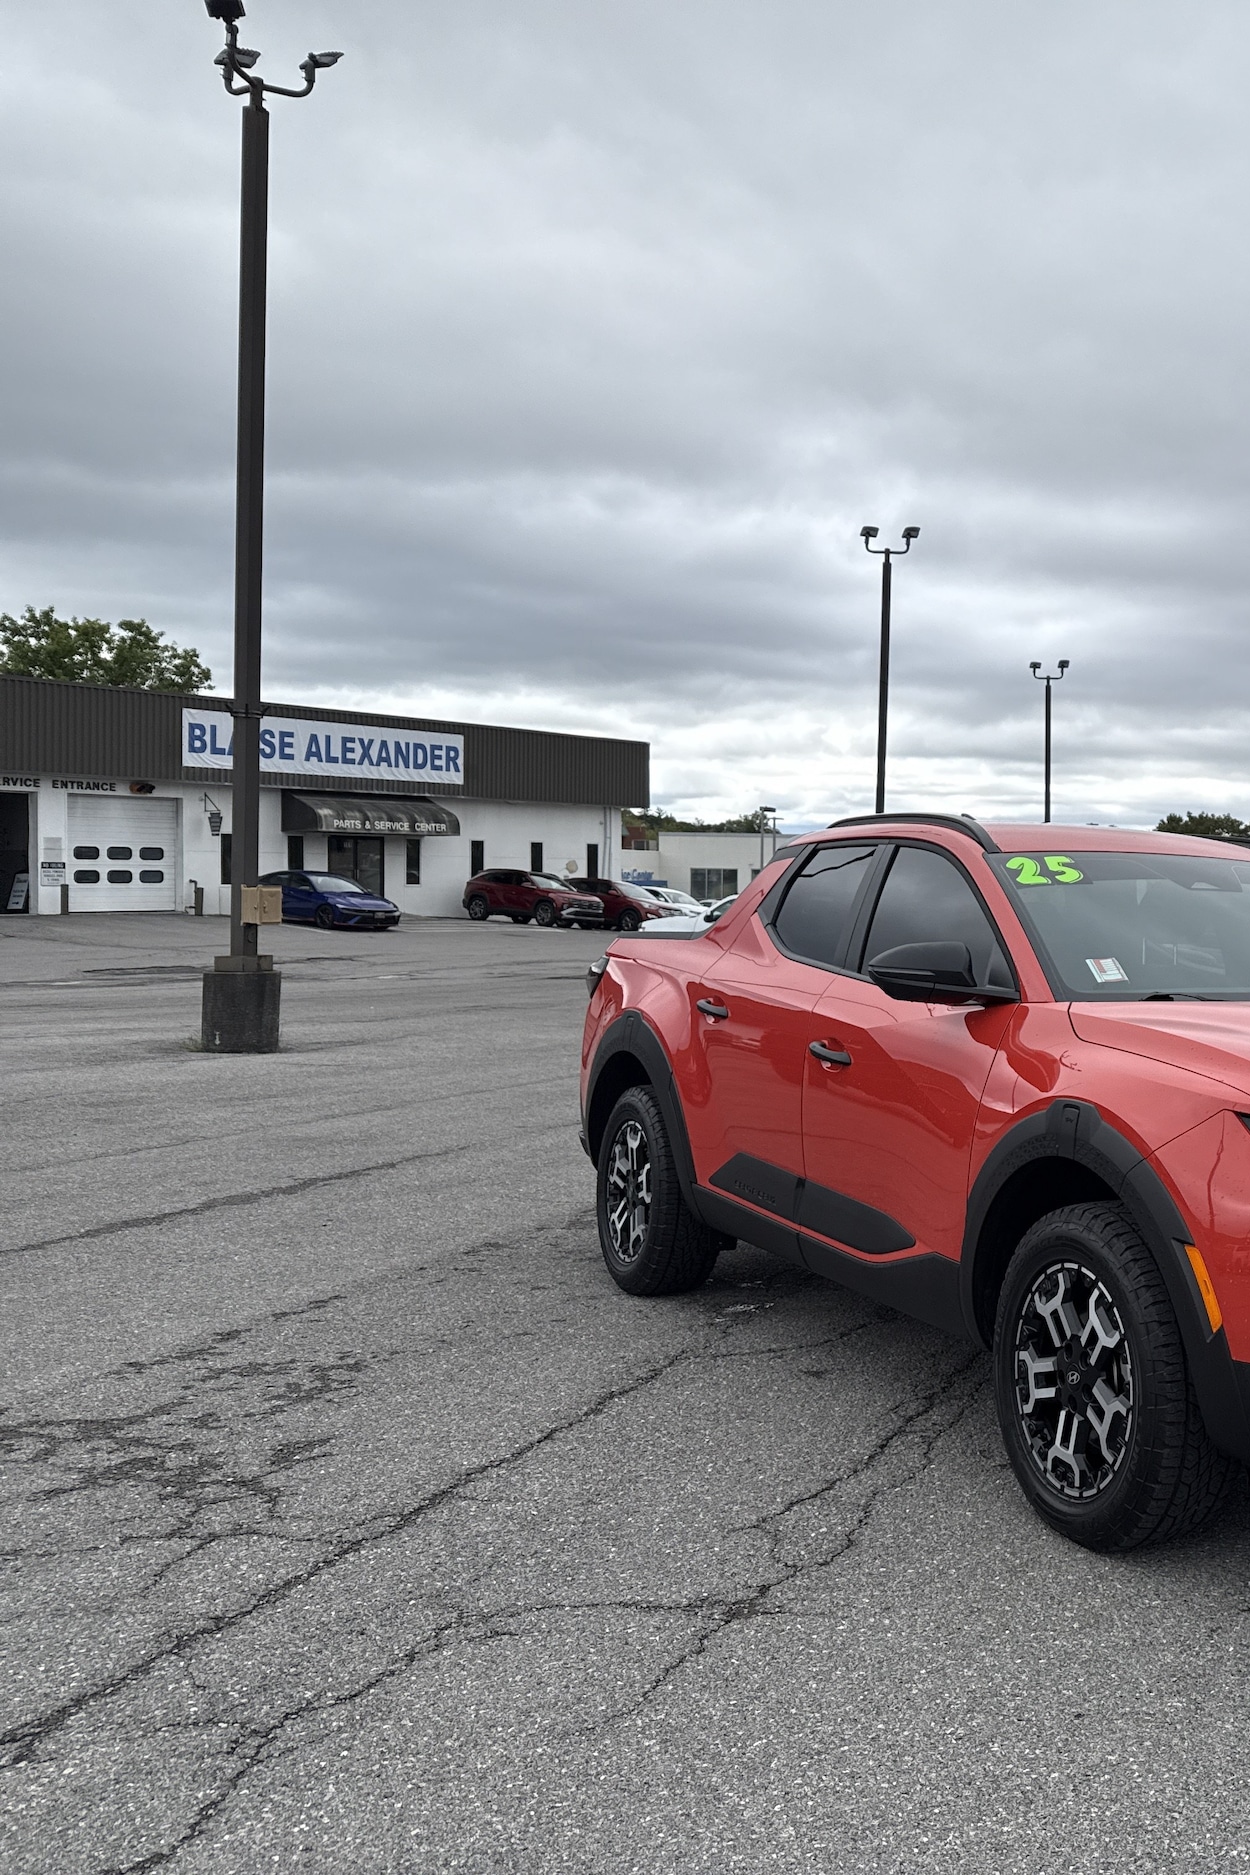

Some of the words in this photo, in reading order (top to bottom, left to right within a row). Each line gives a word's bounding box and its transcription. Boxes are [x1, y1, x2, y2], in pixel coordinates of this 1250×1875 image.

[188, 722, 295, 761] BLSE
[304, 733, 461, 773] ALEXANDER
[52, 780, 117, 791] ENTRANCE
[333, 819, 362, 829] PARTS
[364, 820, 371, 830] &
[374, 821, 410, 831] SERVICE
[415, 822, 447, 832] CENTER
[1005, 855, 1084, 885] 25
